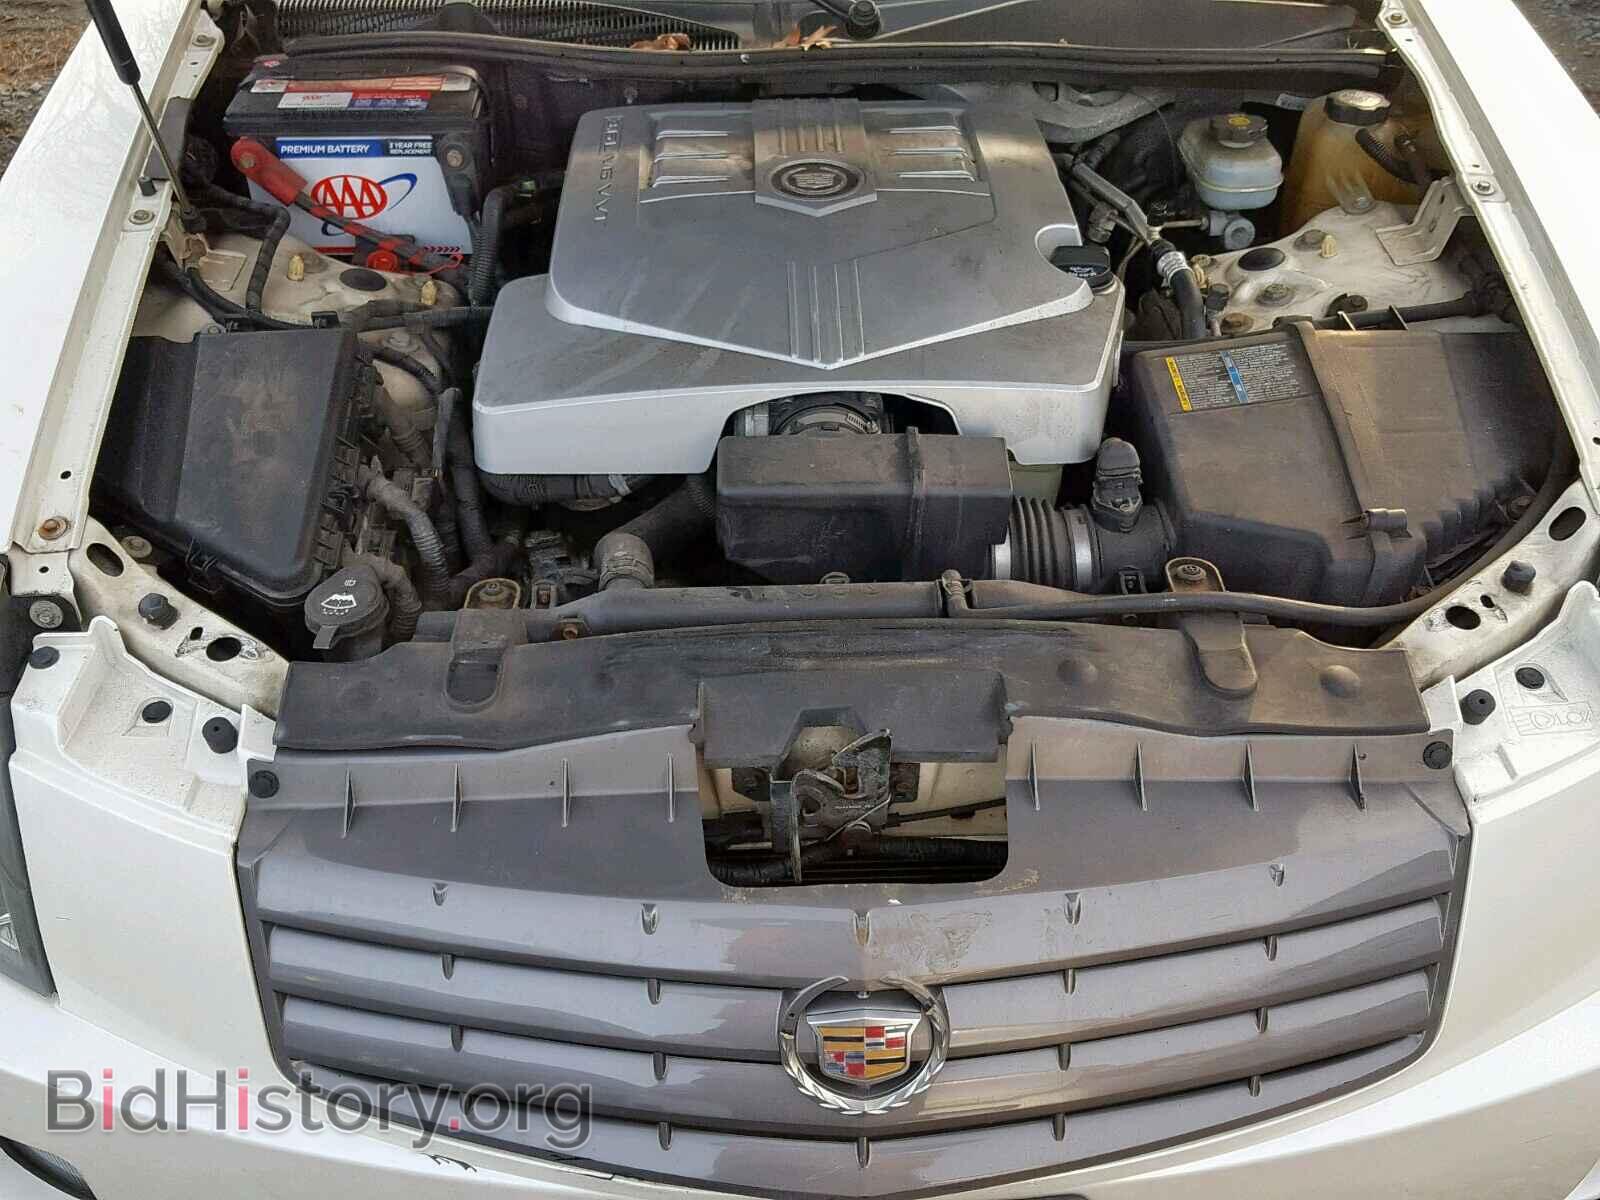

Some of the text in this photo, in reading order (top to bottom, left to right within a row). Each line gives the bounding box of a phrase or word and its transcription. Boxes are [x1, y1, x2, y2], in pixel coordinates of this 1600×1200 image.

[280, 143, 370, 154] PREMIUM BATTERY
[395, 142, 412, 150] YEAR
[414, 141, 432, 149] FREE
[313, 175, 387, 219] AAA
